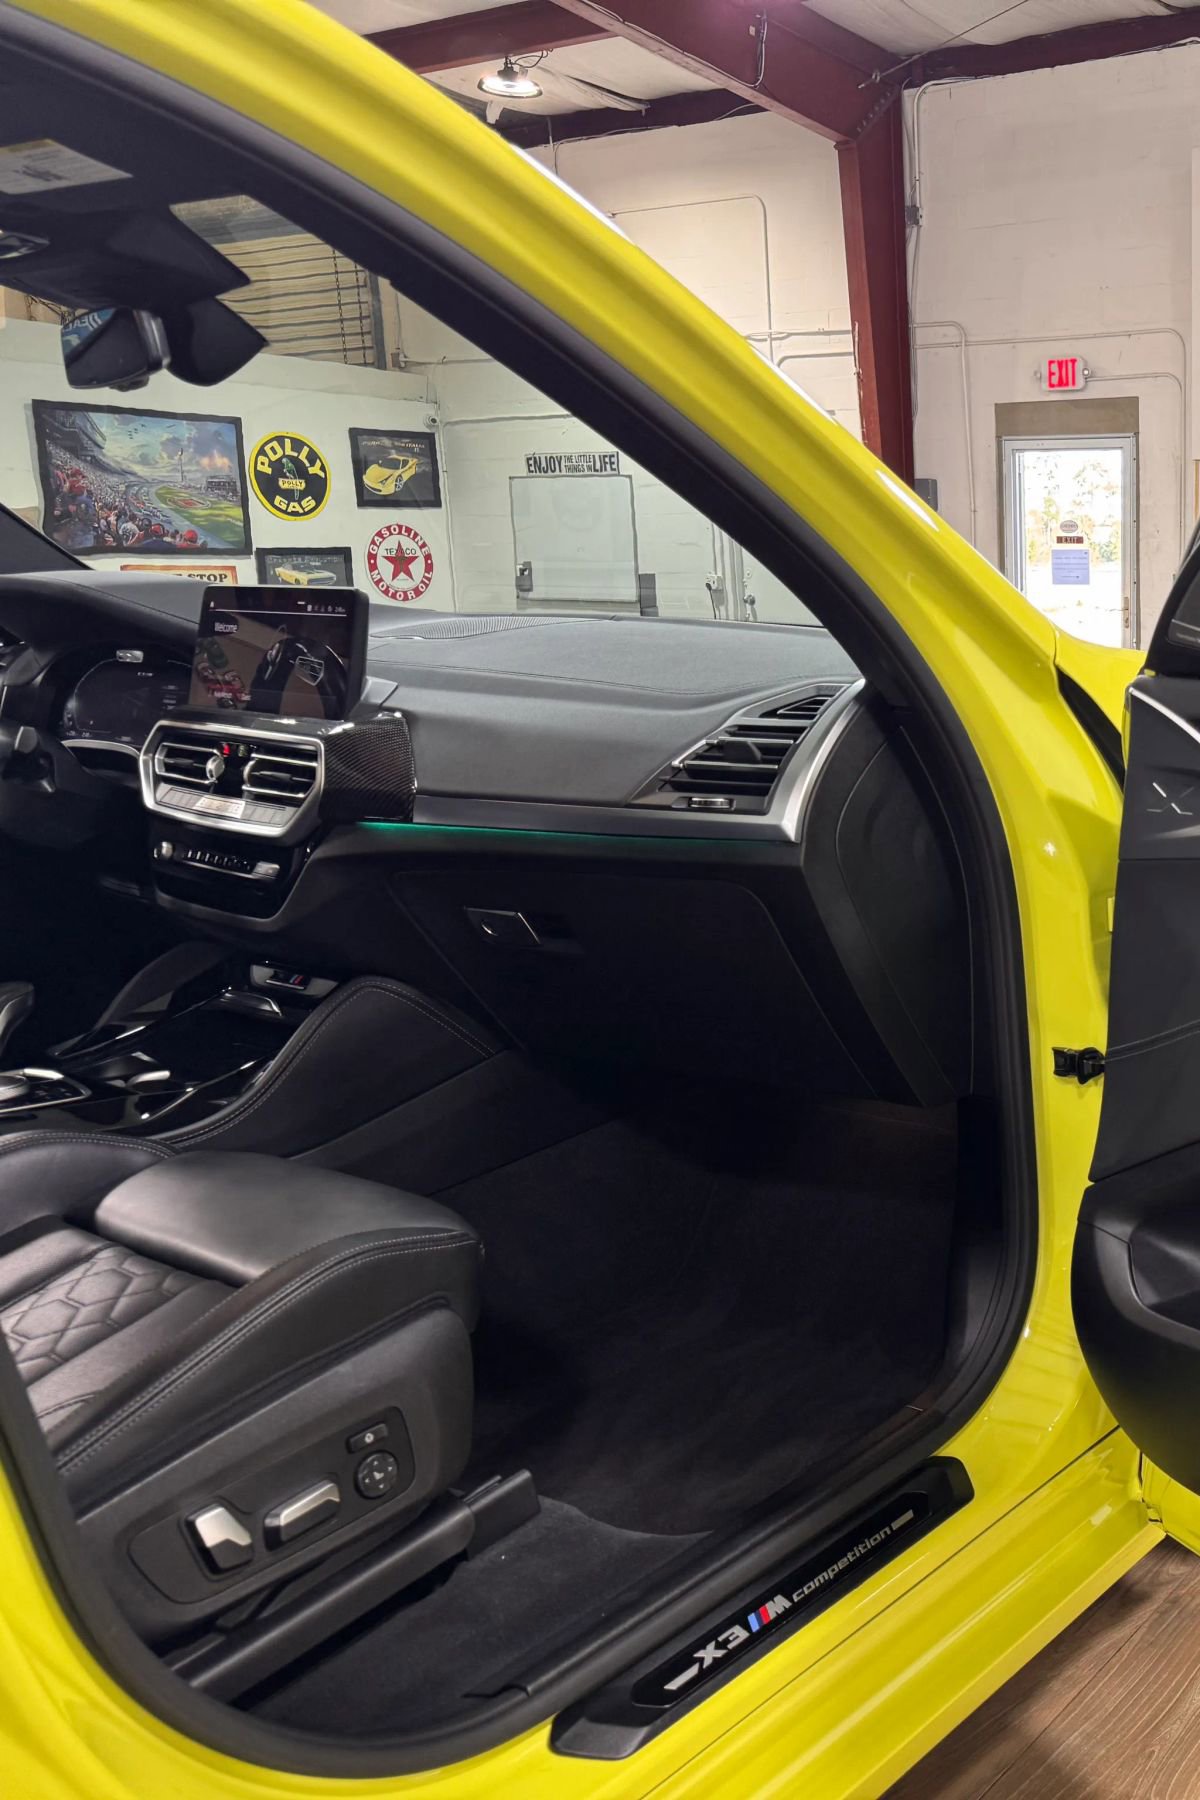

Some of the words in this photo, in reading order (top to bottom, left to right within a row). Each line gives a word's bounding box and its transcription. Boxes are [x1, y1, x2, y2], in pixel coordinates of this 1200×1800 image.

[1047, 358, 1078, 389] EXIT
[257, 438, 326, 479] POLLY
[526, 455, 563, 474] ENJOY
[564, 455, 575, 463] THE
[575, 454, 592, 463] LITTLE
[593, 454, 617, 473] LIFE
[564, 464, 586, 473] THINGS
[281, 479, 303, 487] POLLY
[273, 495, 316, 514] GAS
[369, 525, 431, 557] GASOLINE
[384, 547, 417, 556] TECO
[370, 569, 416, 601] MOTOR
[418, 571, 433, 592] OIL
[693, 1624, 750, 1669] X3
[792, 1526, 892, 1603] competition
